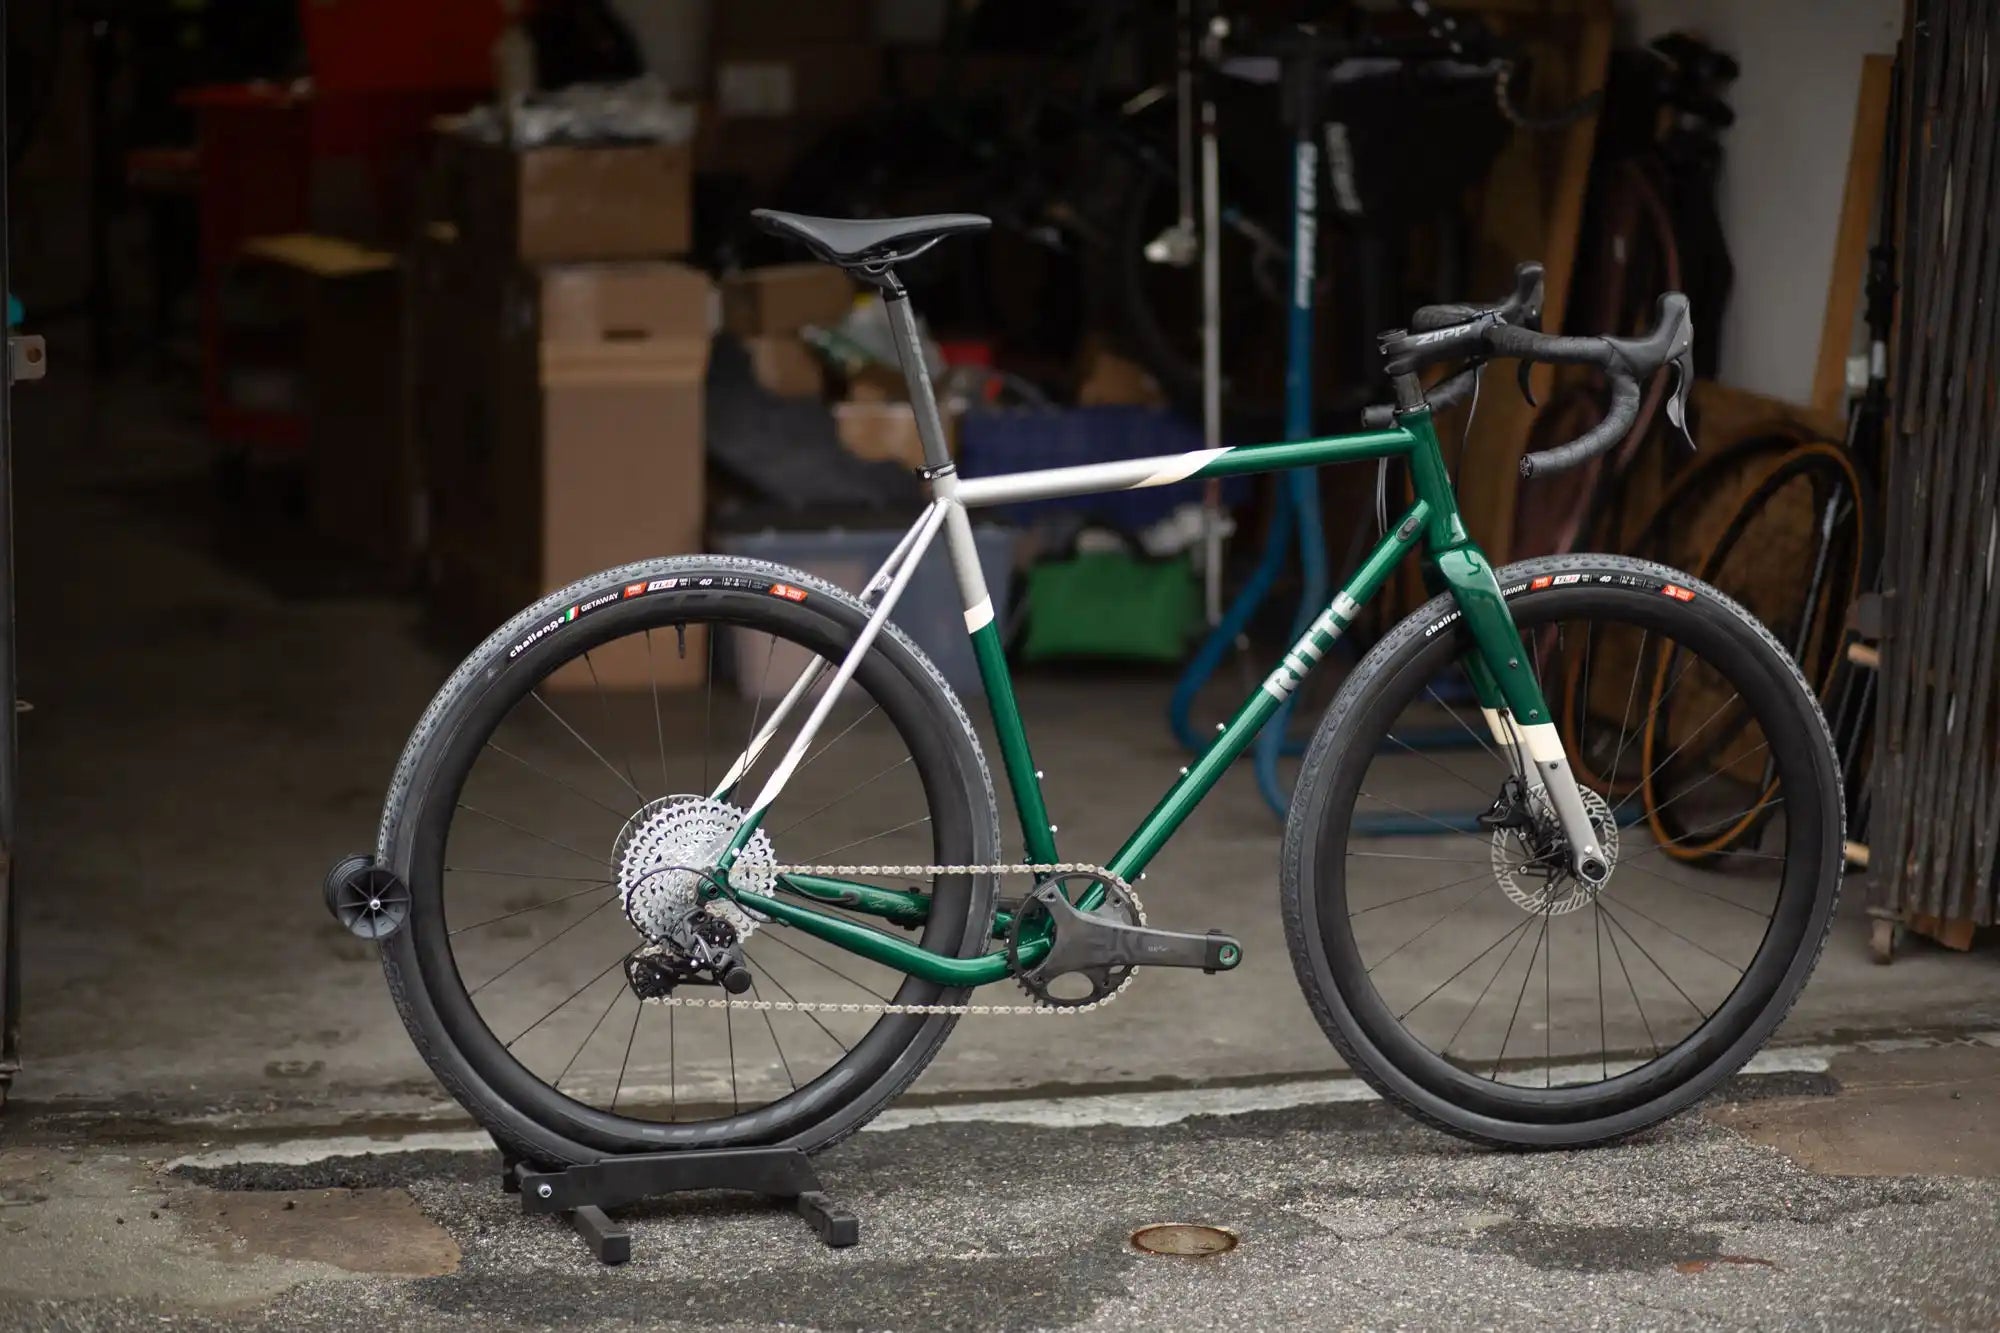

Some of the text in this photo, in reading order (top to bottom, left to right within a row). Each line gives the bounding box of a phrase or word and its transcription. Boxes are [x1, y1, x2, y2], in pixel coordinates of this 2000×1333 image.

[1416, 325, 1471, 346] ZIPP
[1599, 575, 1612, 583] 40
[510, 616, 565, 658] challenge
[581, 592, 619, 612] GETAWAY
[699, 578, 713, 586] 40
